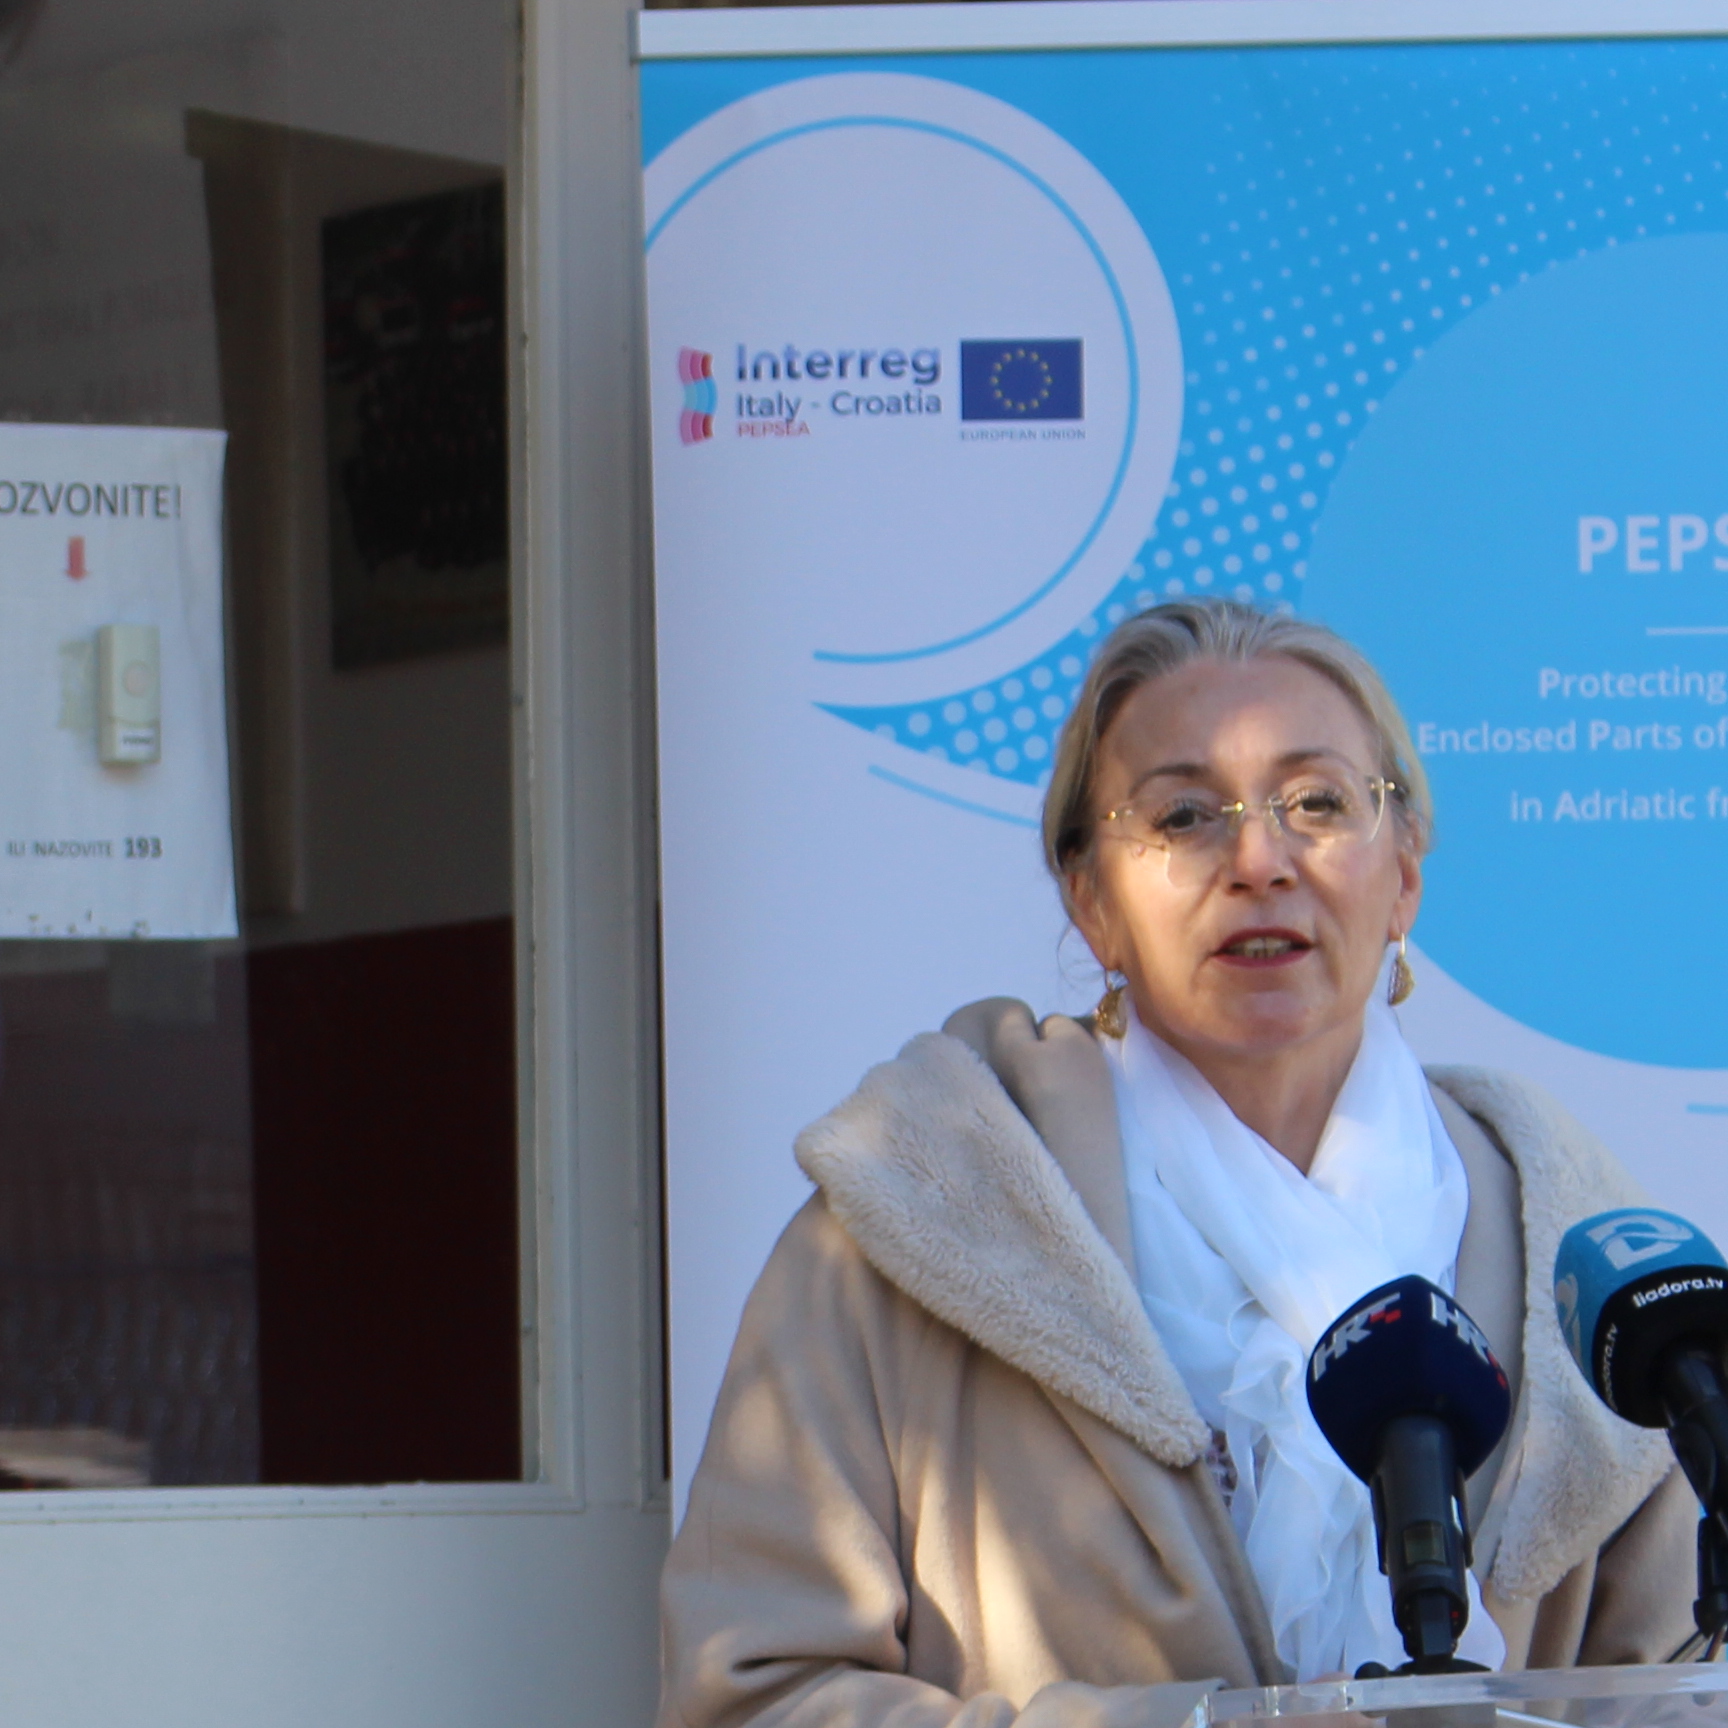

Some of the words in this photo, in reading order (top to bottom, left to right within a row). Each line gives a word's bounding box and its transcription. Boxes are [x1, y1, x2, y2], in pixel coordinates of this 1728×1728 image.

[737, 344, 942, 385] Interreg
[737, 391, 802, 423] Italy
[831, 388, 942, 415] Croatia
[737, 420, 810, 437] PEPSEA
[960, 429, 1037, 440] EUROPEAN
[1042, 429, 1086, 440] UNION
[1538, 666, 1728, 704] Protecting
[1417, 721, 1576, 755] Enclosed
[1588, 720, 1683, 752] Parts
[1510, 792, 1543, 822] in
[1554, 789, 1696, 821] Adriatic
[125, 837, 164, 858] 193
